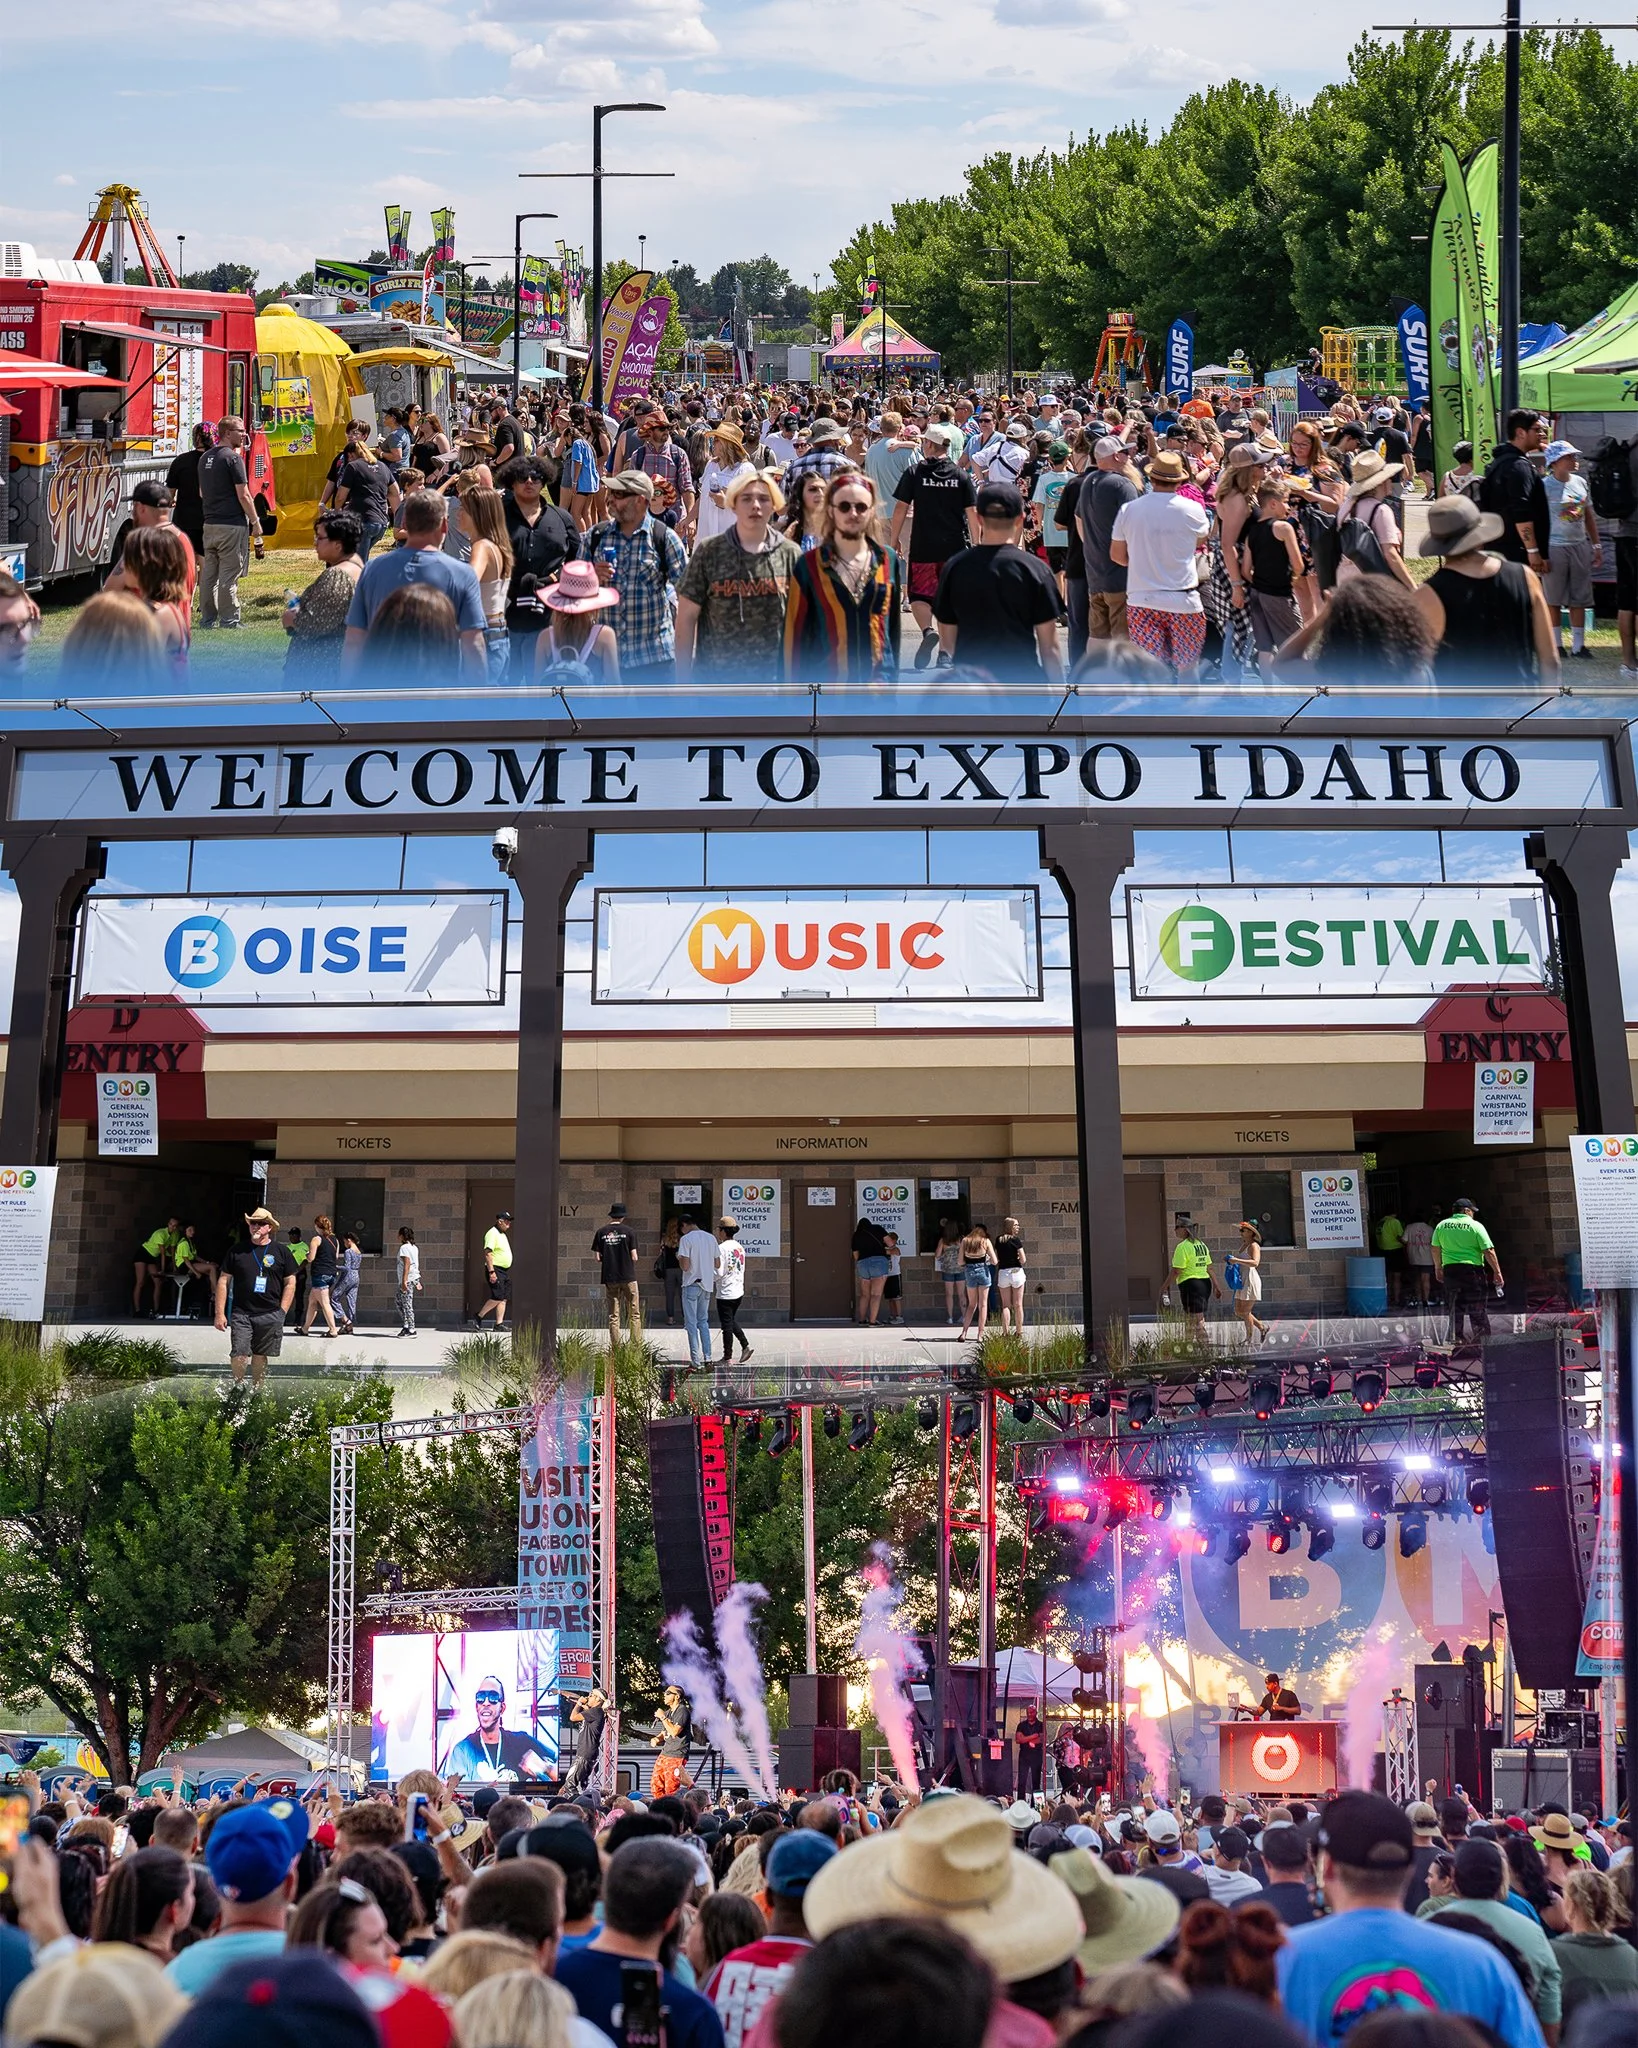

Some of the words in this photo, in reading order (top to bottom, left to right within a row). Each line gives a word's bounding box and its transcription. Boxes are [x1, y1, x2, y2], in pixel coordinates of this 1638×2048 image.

[374, 279, 406, 294] CURLY
[407, 278, 437, 291] FRS
[9, 306, 35, 314] SMOKING
[447, 305, 505, 321] WOPPER
[0, 314, 23, 323] WITHIN
[607, 322, 627, 334] Best
[833, 355, 872, 365] BASS
[1171, 329, 1189, 388] SURF
[1403, 318, 1430, 390] SURF
[618, 376, 650, 389] BOWLS
[108, 745, 638, 812] WELCOME
[687, 743, 820, 803] TO
[872, 742, 1142, 802] EXPO
[1190, 743, 1521, 803] IDAHO
[178, 925, 408, 975] BOISE
[700, 919, 946, 972] MUSIC
[1177, 918, 1530, 969] FESTIVAL
[1485, 988, 1513, 1022] C
[109, 998, 140, 1034] D
[1438, 1032, 1568, 1062] ENTRY
[65, 1043, 190, 1073] ENTRY
[1482, 1070, 1527, 1083] BMF
[105, 1081, 149, 1095] BMF
[336, 1137, 392, 1149] TICKETS
[776, 1136, 868, 1149] INFORMATION
[1234, 1130, 1290, 1143] TICKETS
[1309, 1178, 1352, 1191] BMF
[730, 1186, 773, 1199] BMF
[864, 1187, 907, 1200] BMF
[1314, 1200, 1350, 1208] CARNIVAL
[1311, 1208, 1355, 1216] WRISTBAND
[1310, 1216, 1357, 1224] REDEMPTION
[1444, 1222, 1471, 1230] SECURITY
[521, 1465, 590, 1498] VISIT
[520, 1503, 549, 1530] US
[553, 1502, 590, 1529] ON
[520, 1533, 591, 1550] FACBOO
[520, 1554, 548, 1577] TO
